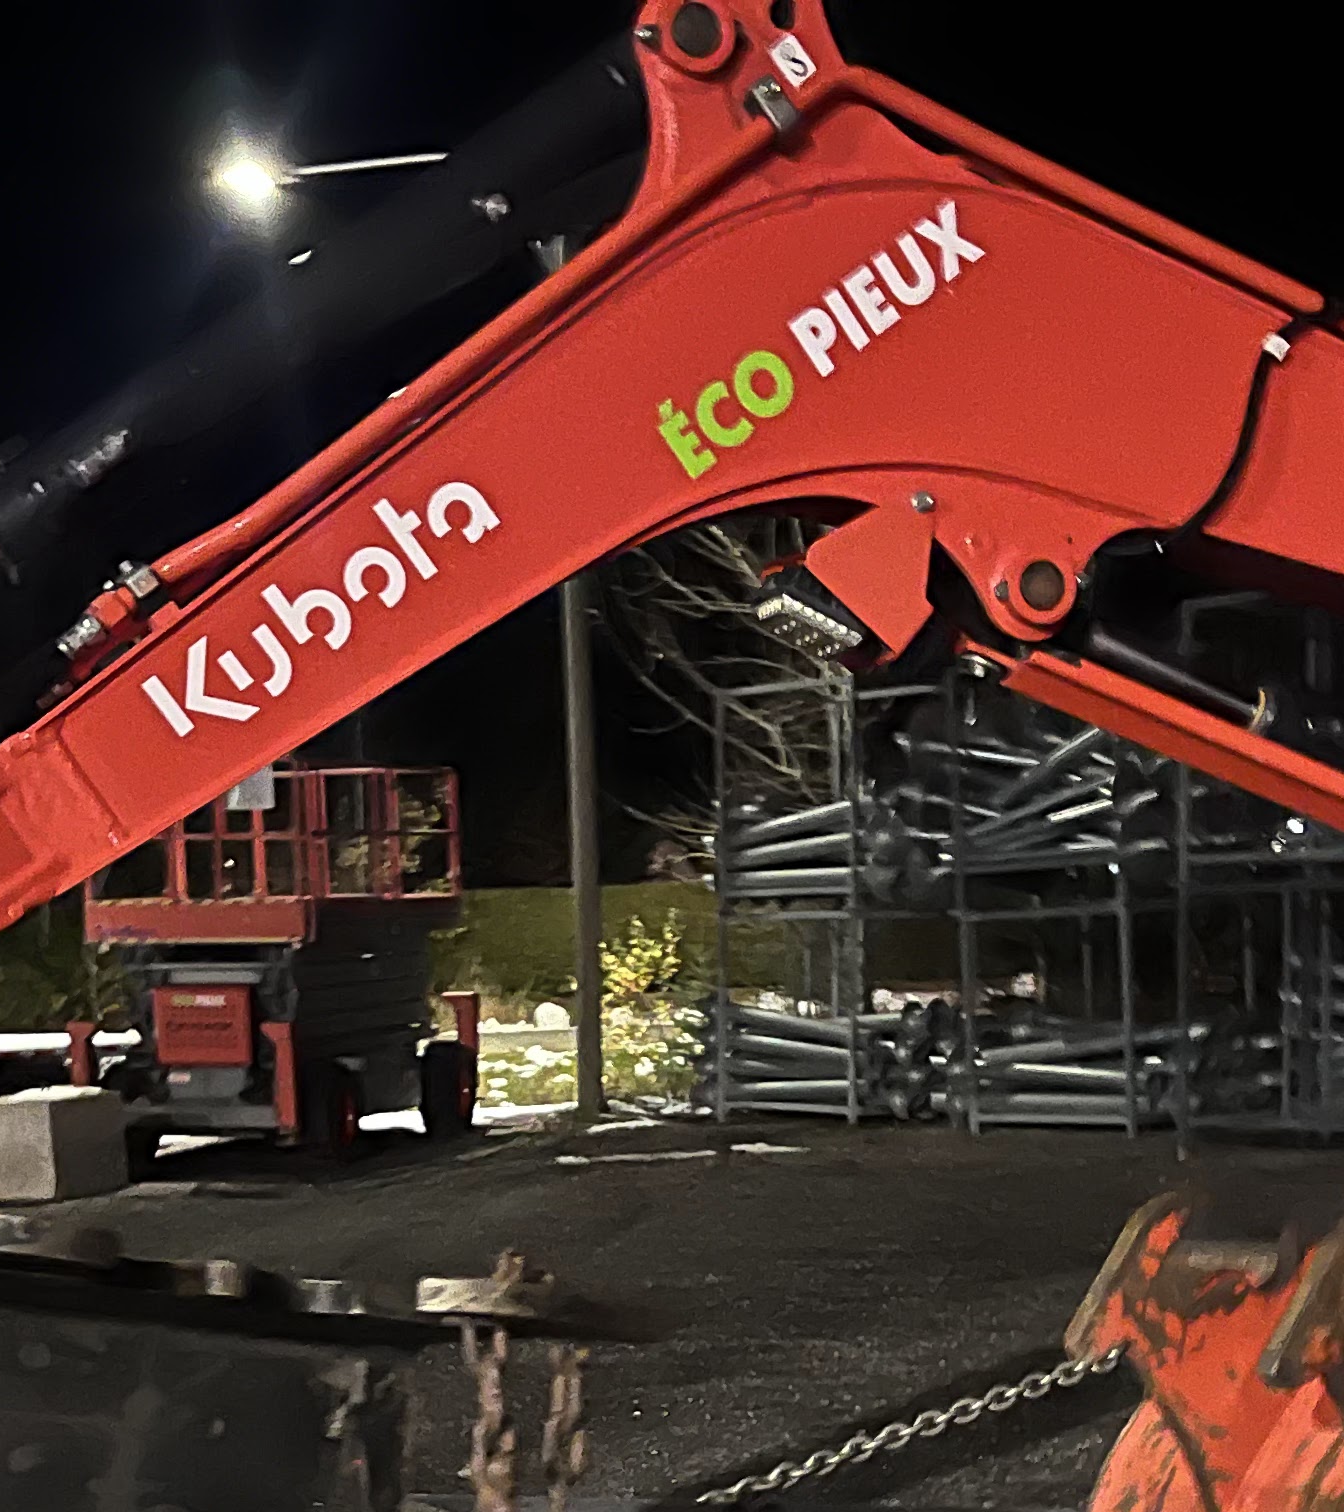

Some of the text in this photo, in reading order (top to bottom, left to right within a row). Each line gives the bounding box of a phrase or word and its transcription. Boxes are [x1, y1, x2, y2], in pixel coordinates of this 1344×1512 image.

[656, 199, 986, 482] ÉCO PIEUX
[140, 480, 502, 739] Kubota
